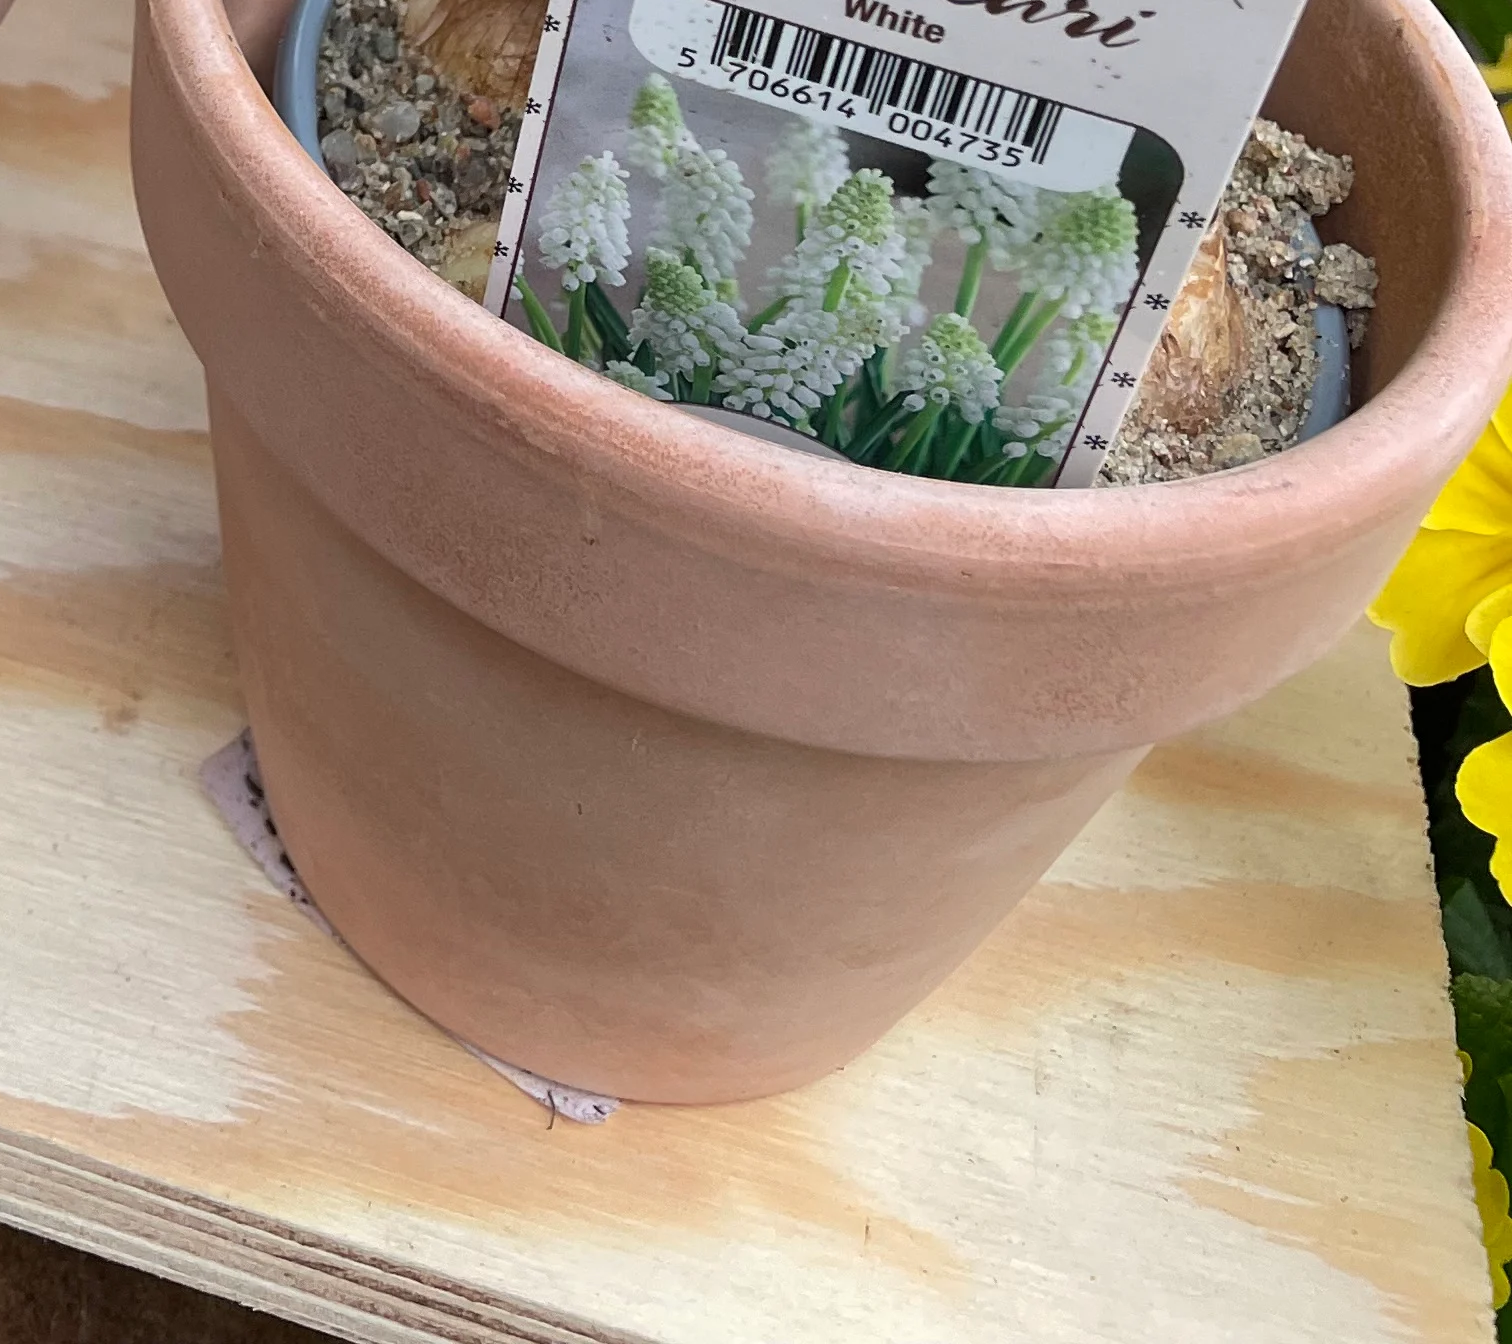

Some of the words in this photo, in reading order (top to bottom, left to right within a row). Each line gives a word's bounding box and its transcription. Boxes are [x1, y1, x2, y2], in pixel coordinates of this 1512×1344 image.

[677, 47, 699, 69] 5
[727, 60, 857, 119] 706614
[888, 113, 1023, 168] 004735
